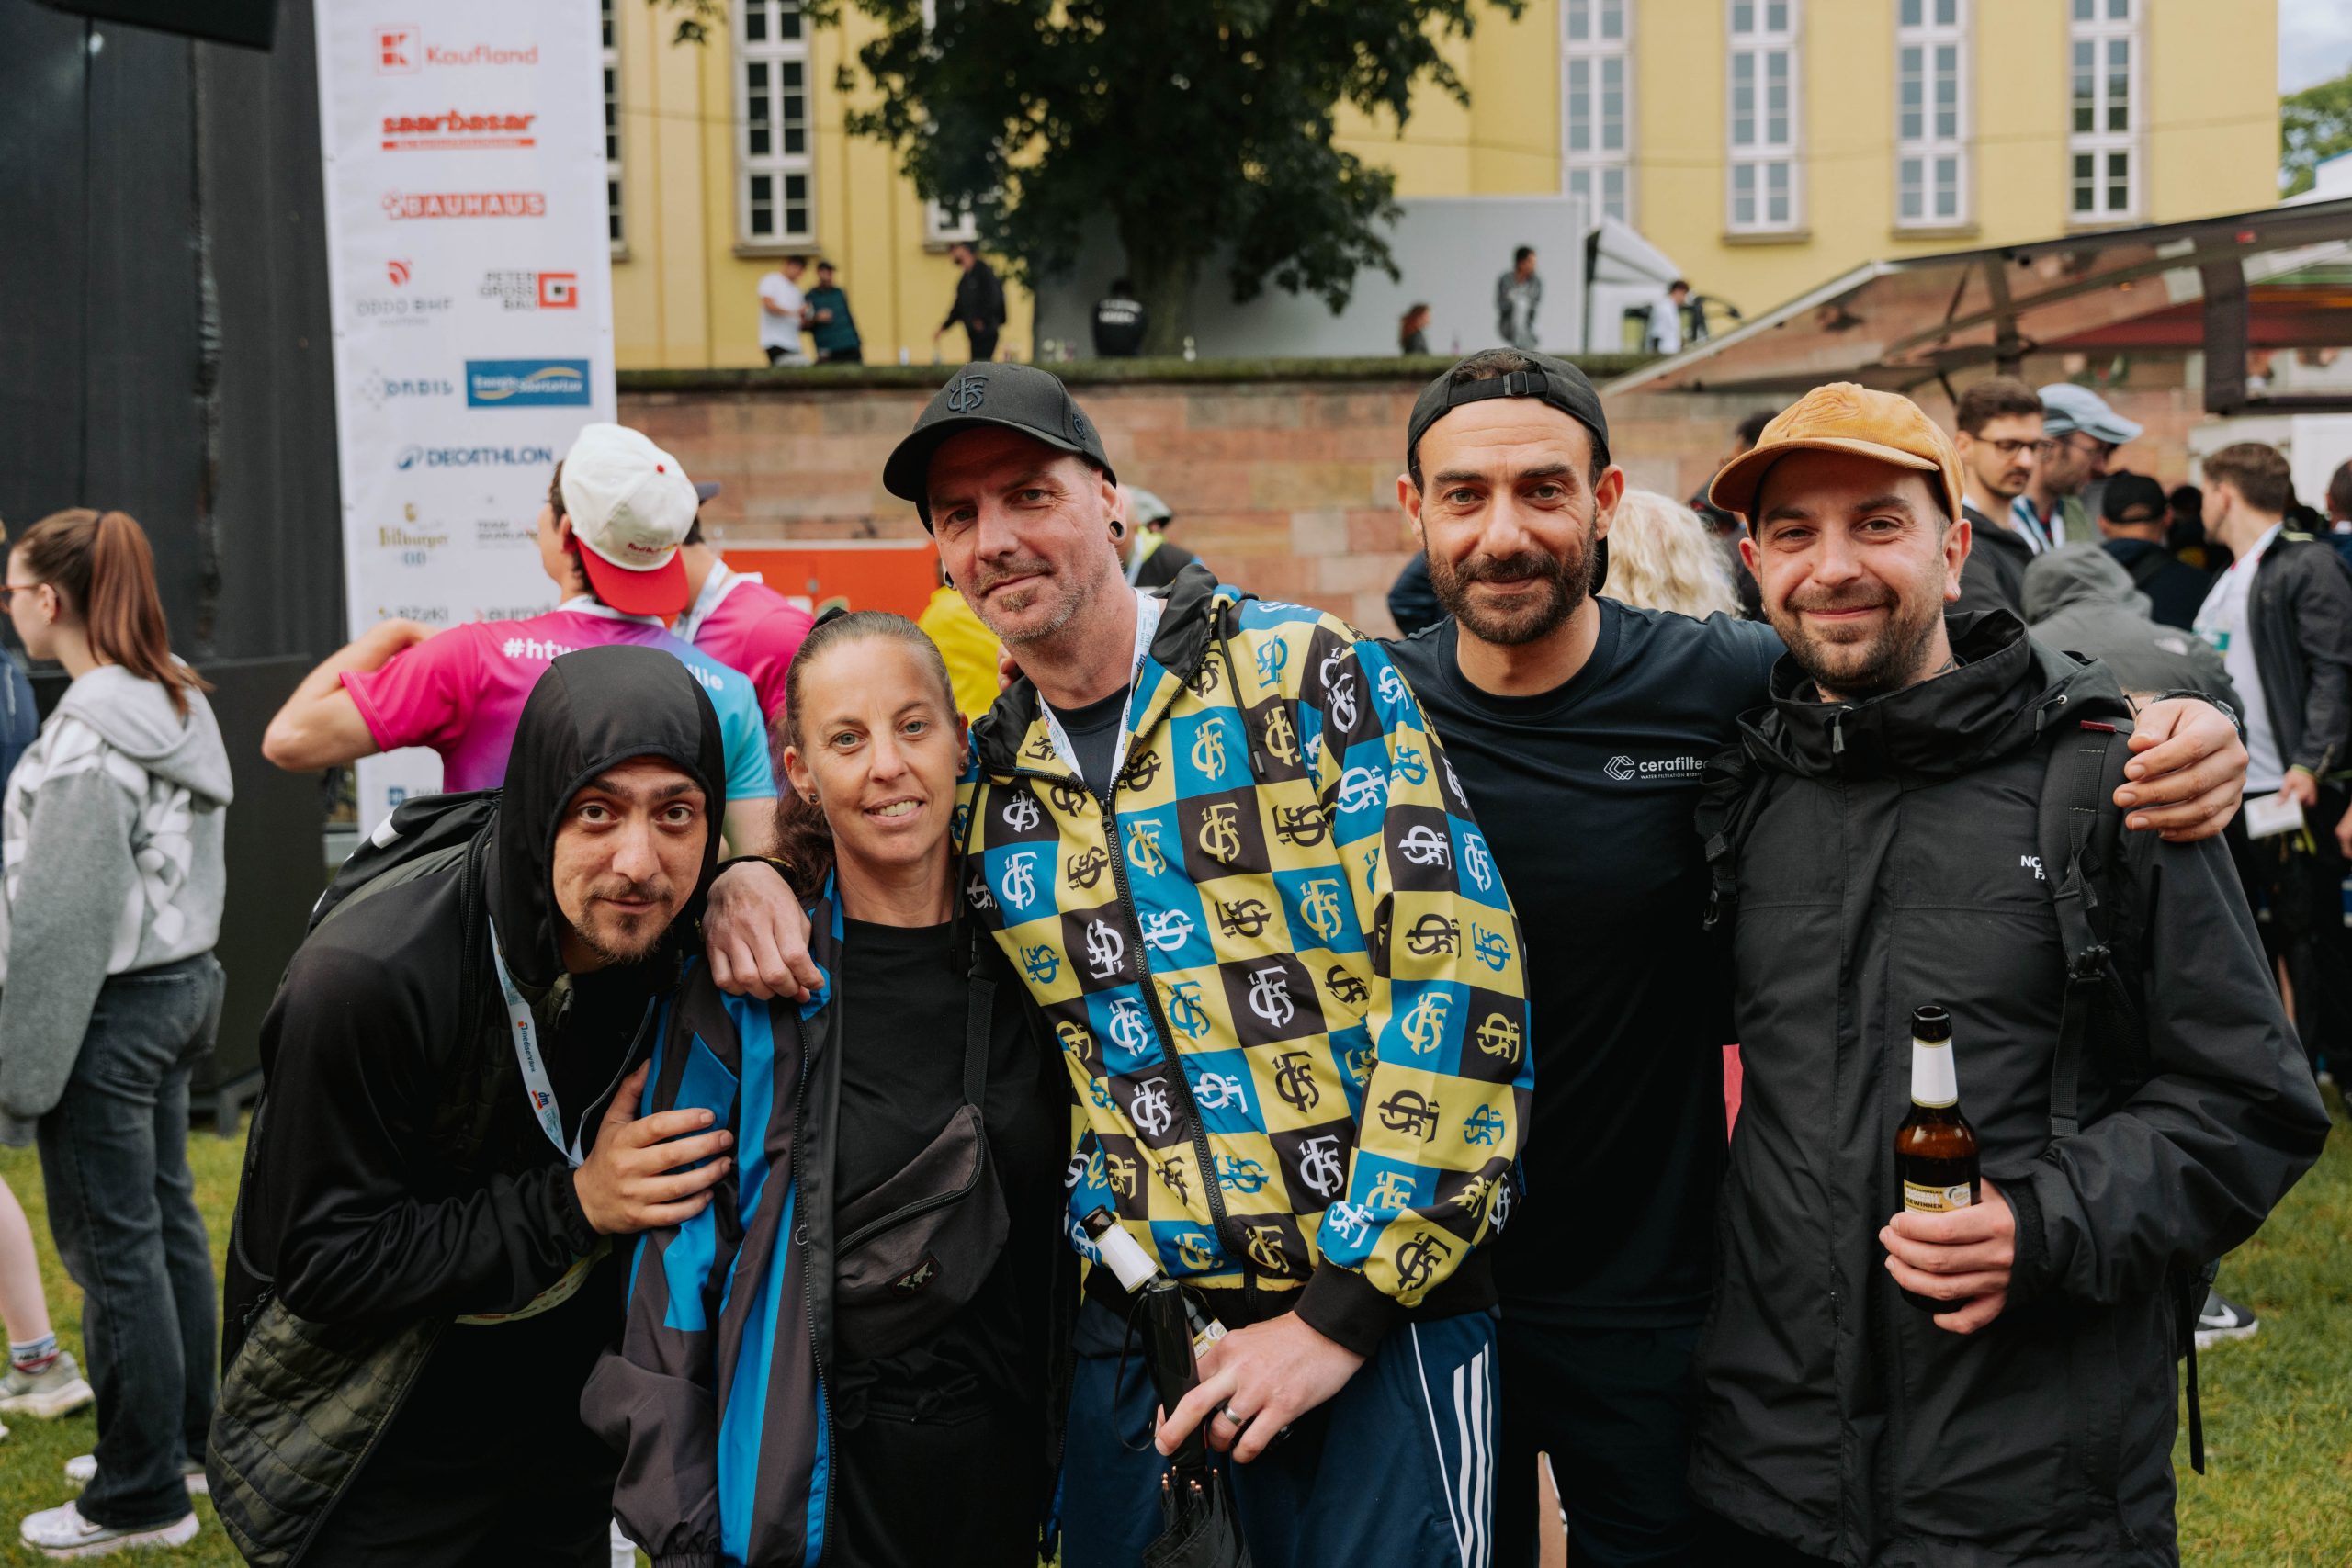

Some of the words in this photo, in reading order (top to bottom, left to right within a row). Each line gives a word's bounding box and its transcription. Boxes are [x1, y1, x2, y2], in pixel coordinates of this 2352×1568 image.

[426, 45, 539, 65] Kaufland
[382, 110, 536, 134] saarbasar
[405, 192, 546, 218] BAUHAUS
[427, 446, 553, 467] DECATHLON
[538, 1091, 550, 1106] dm
[1905, 1197, 1943, 1209] GEWINNEN
